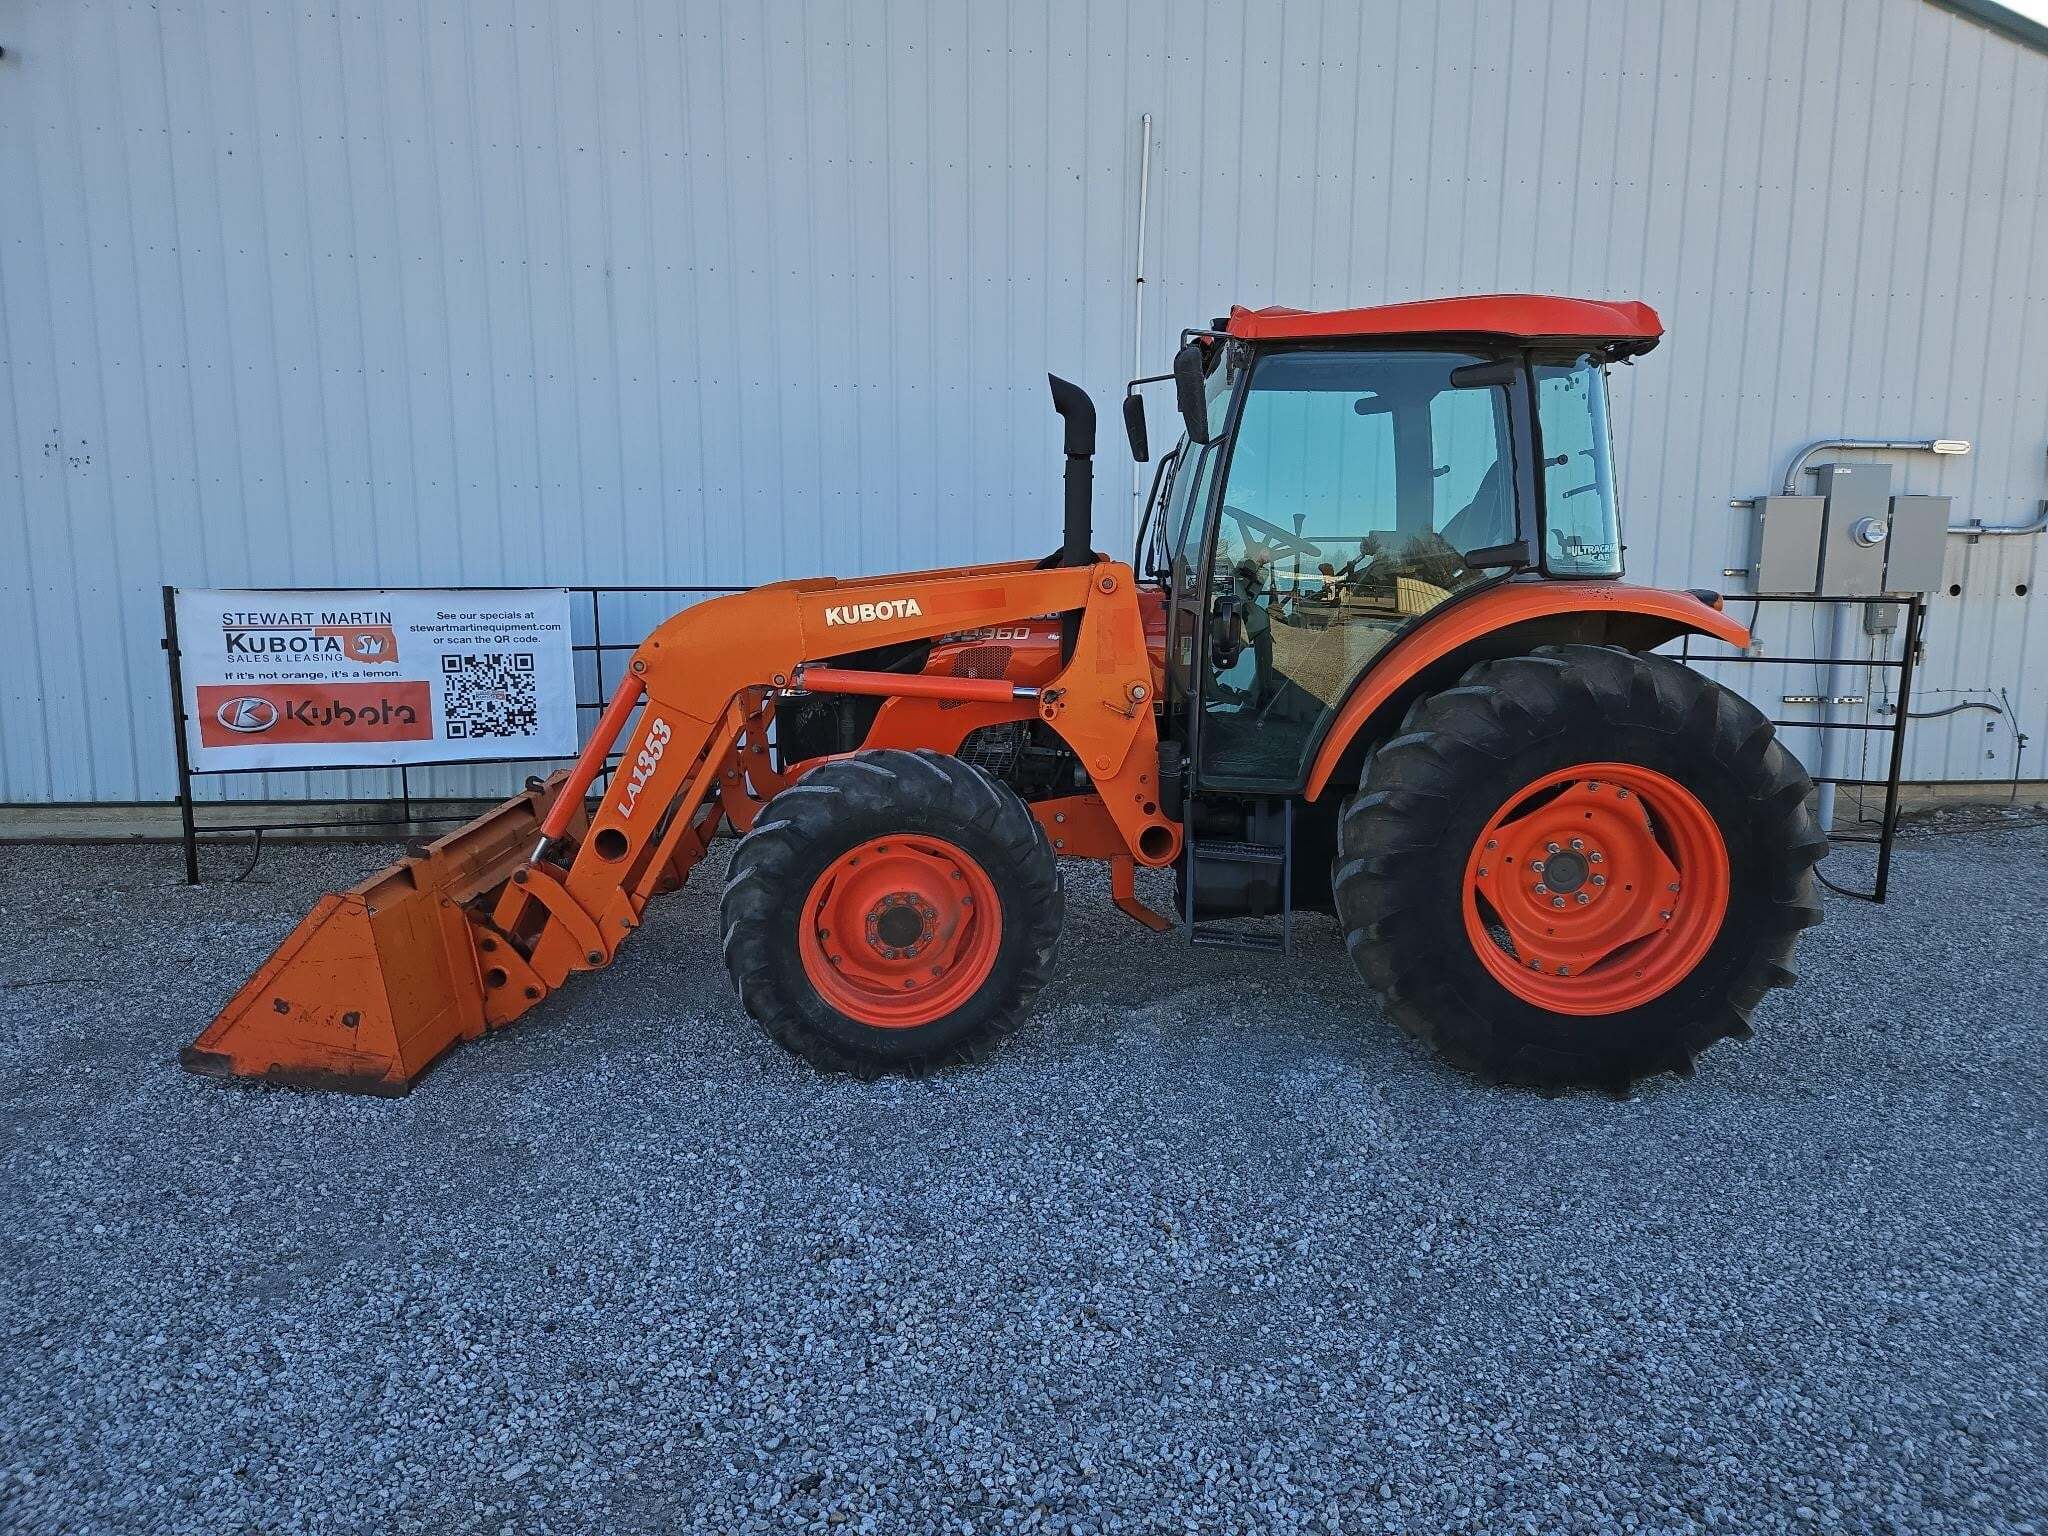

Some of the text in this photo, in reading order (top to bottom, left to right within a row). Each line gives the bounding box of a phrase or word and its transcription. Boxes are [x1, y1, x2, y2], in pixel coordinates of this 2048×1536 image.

[222, 611, 392, 626] STEWART MARTIN
[436, 611, 457, 620] See
[480, 611, 522, 622] specials
[524, 611, 535, 619] at
[824, 598, 923, 627] KUBOTA
[410, 623, 561, 633] stewartmartinequipment.com
[433, 637, 444, 645] or
[475, 635, 491, 644] the
[494, 635, 511, 644] QR
[513, 635, 541, 644] code.
[227, 653, 343, 664] SALES & LEASING
[225, 672, 233, 680] If
[236, 671, 255, 680] it's
[258, 671, 278, 679] not
[281, 671, 328, 681] orange,
[331, 670, 349, 678] it's
[363, 669, 402, 678] lemon.
[286, 699, 417, 726] Kubota
[617, 718, 672, 820] LA1353
